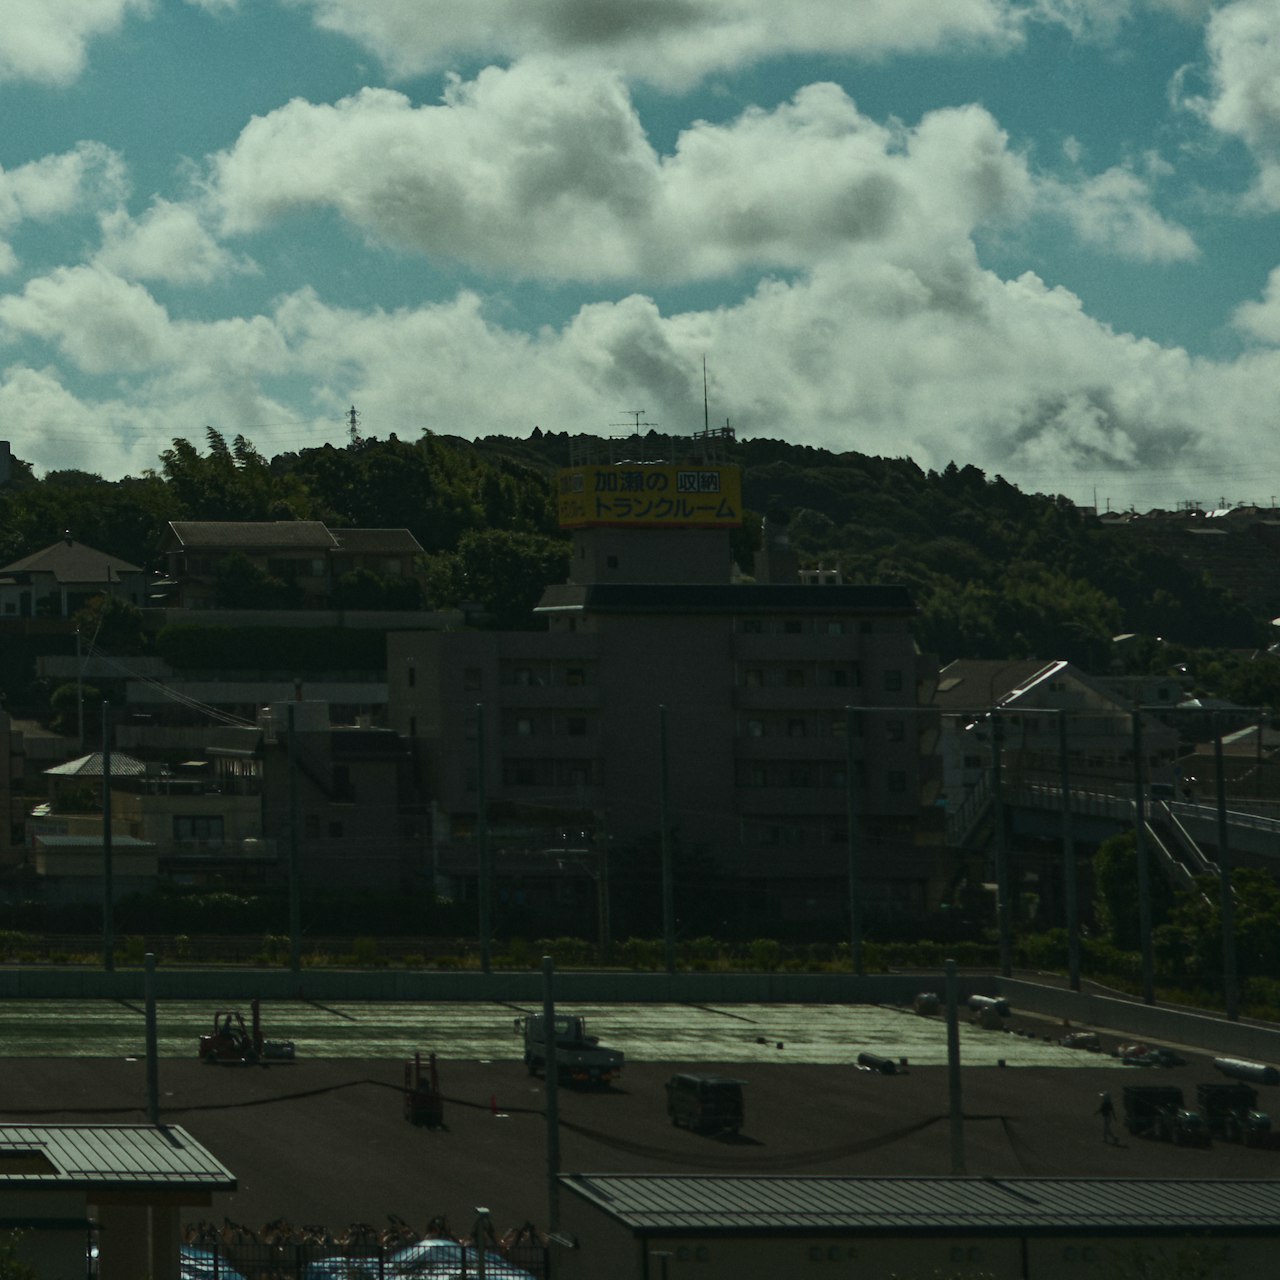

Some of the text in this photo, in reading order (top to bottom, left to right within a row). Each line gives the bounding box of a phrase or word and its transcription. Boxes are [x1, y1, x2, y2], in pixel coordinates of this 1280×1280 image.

[596, 498, 736, 518] トランクルーム
